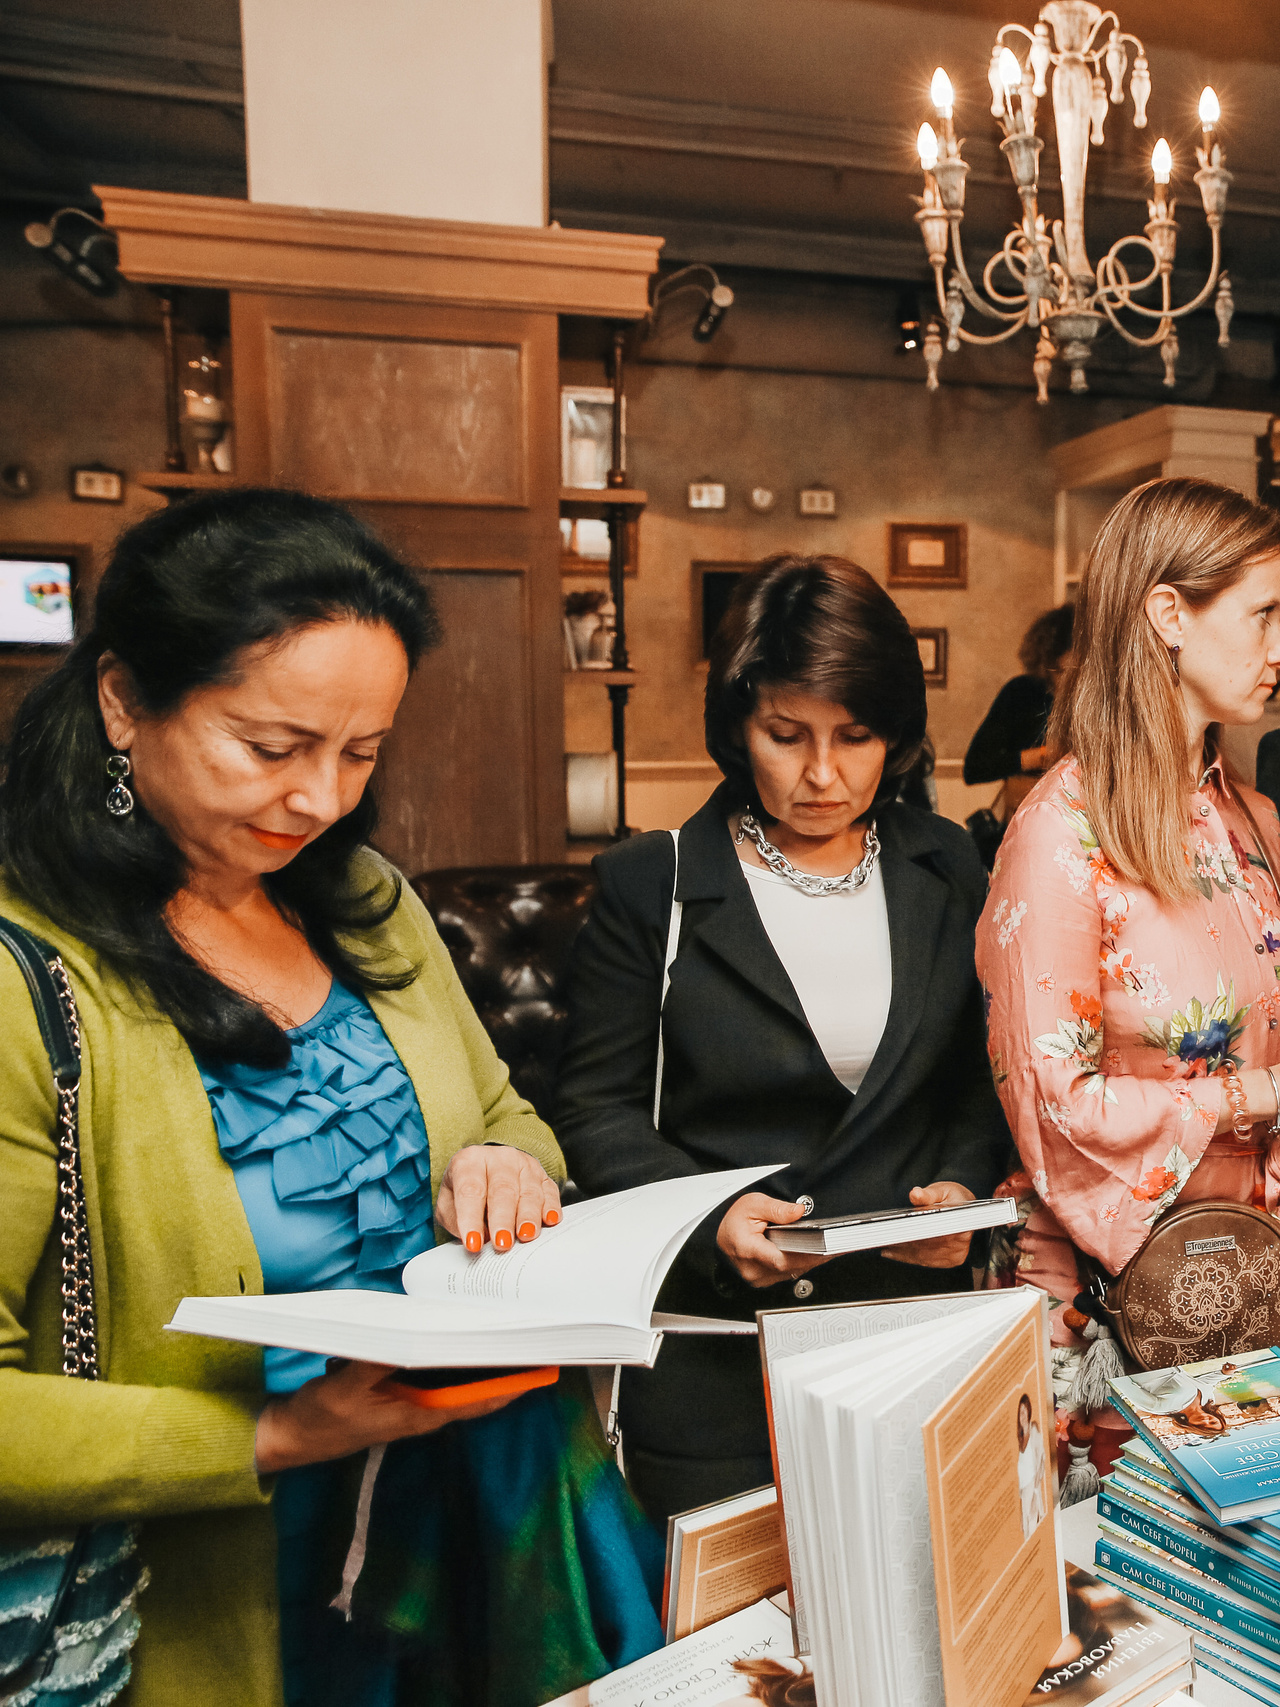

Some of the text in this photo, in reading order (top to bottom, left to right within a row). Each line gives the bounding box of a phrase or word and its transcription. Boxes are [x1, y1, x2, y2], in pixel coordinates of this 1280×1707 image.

[1235, 1450, 1280, 1466] СЕБЕ
[1121, 1512, 1141, 1534] САМ
[1142, 1522, 1162, 1543] СЕБЕ
[1164, 1534, 1198, 1563] ТВОРЕЦ
[1121, 1561, 1143, 1581] САМ
[1144, 1572, 1167, 1592] СЕБЕ
[1168, 1584, 1205, 1612] ТВОРЕЦ
[1037, 1620, 1151, 1694] ПАВЛОВСКАЯ
[1090, 1631, 1165, 1680] ЕВГЕНИЯ
[653, 1667, 718, 1702] СВОЮ
